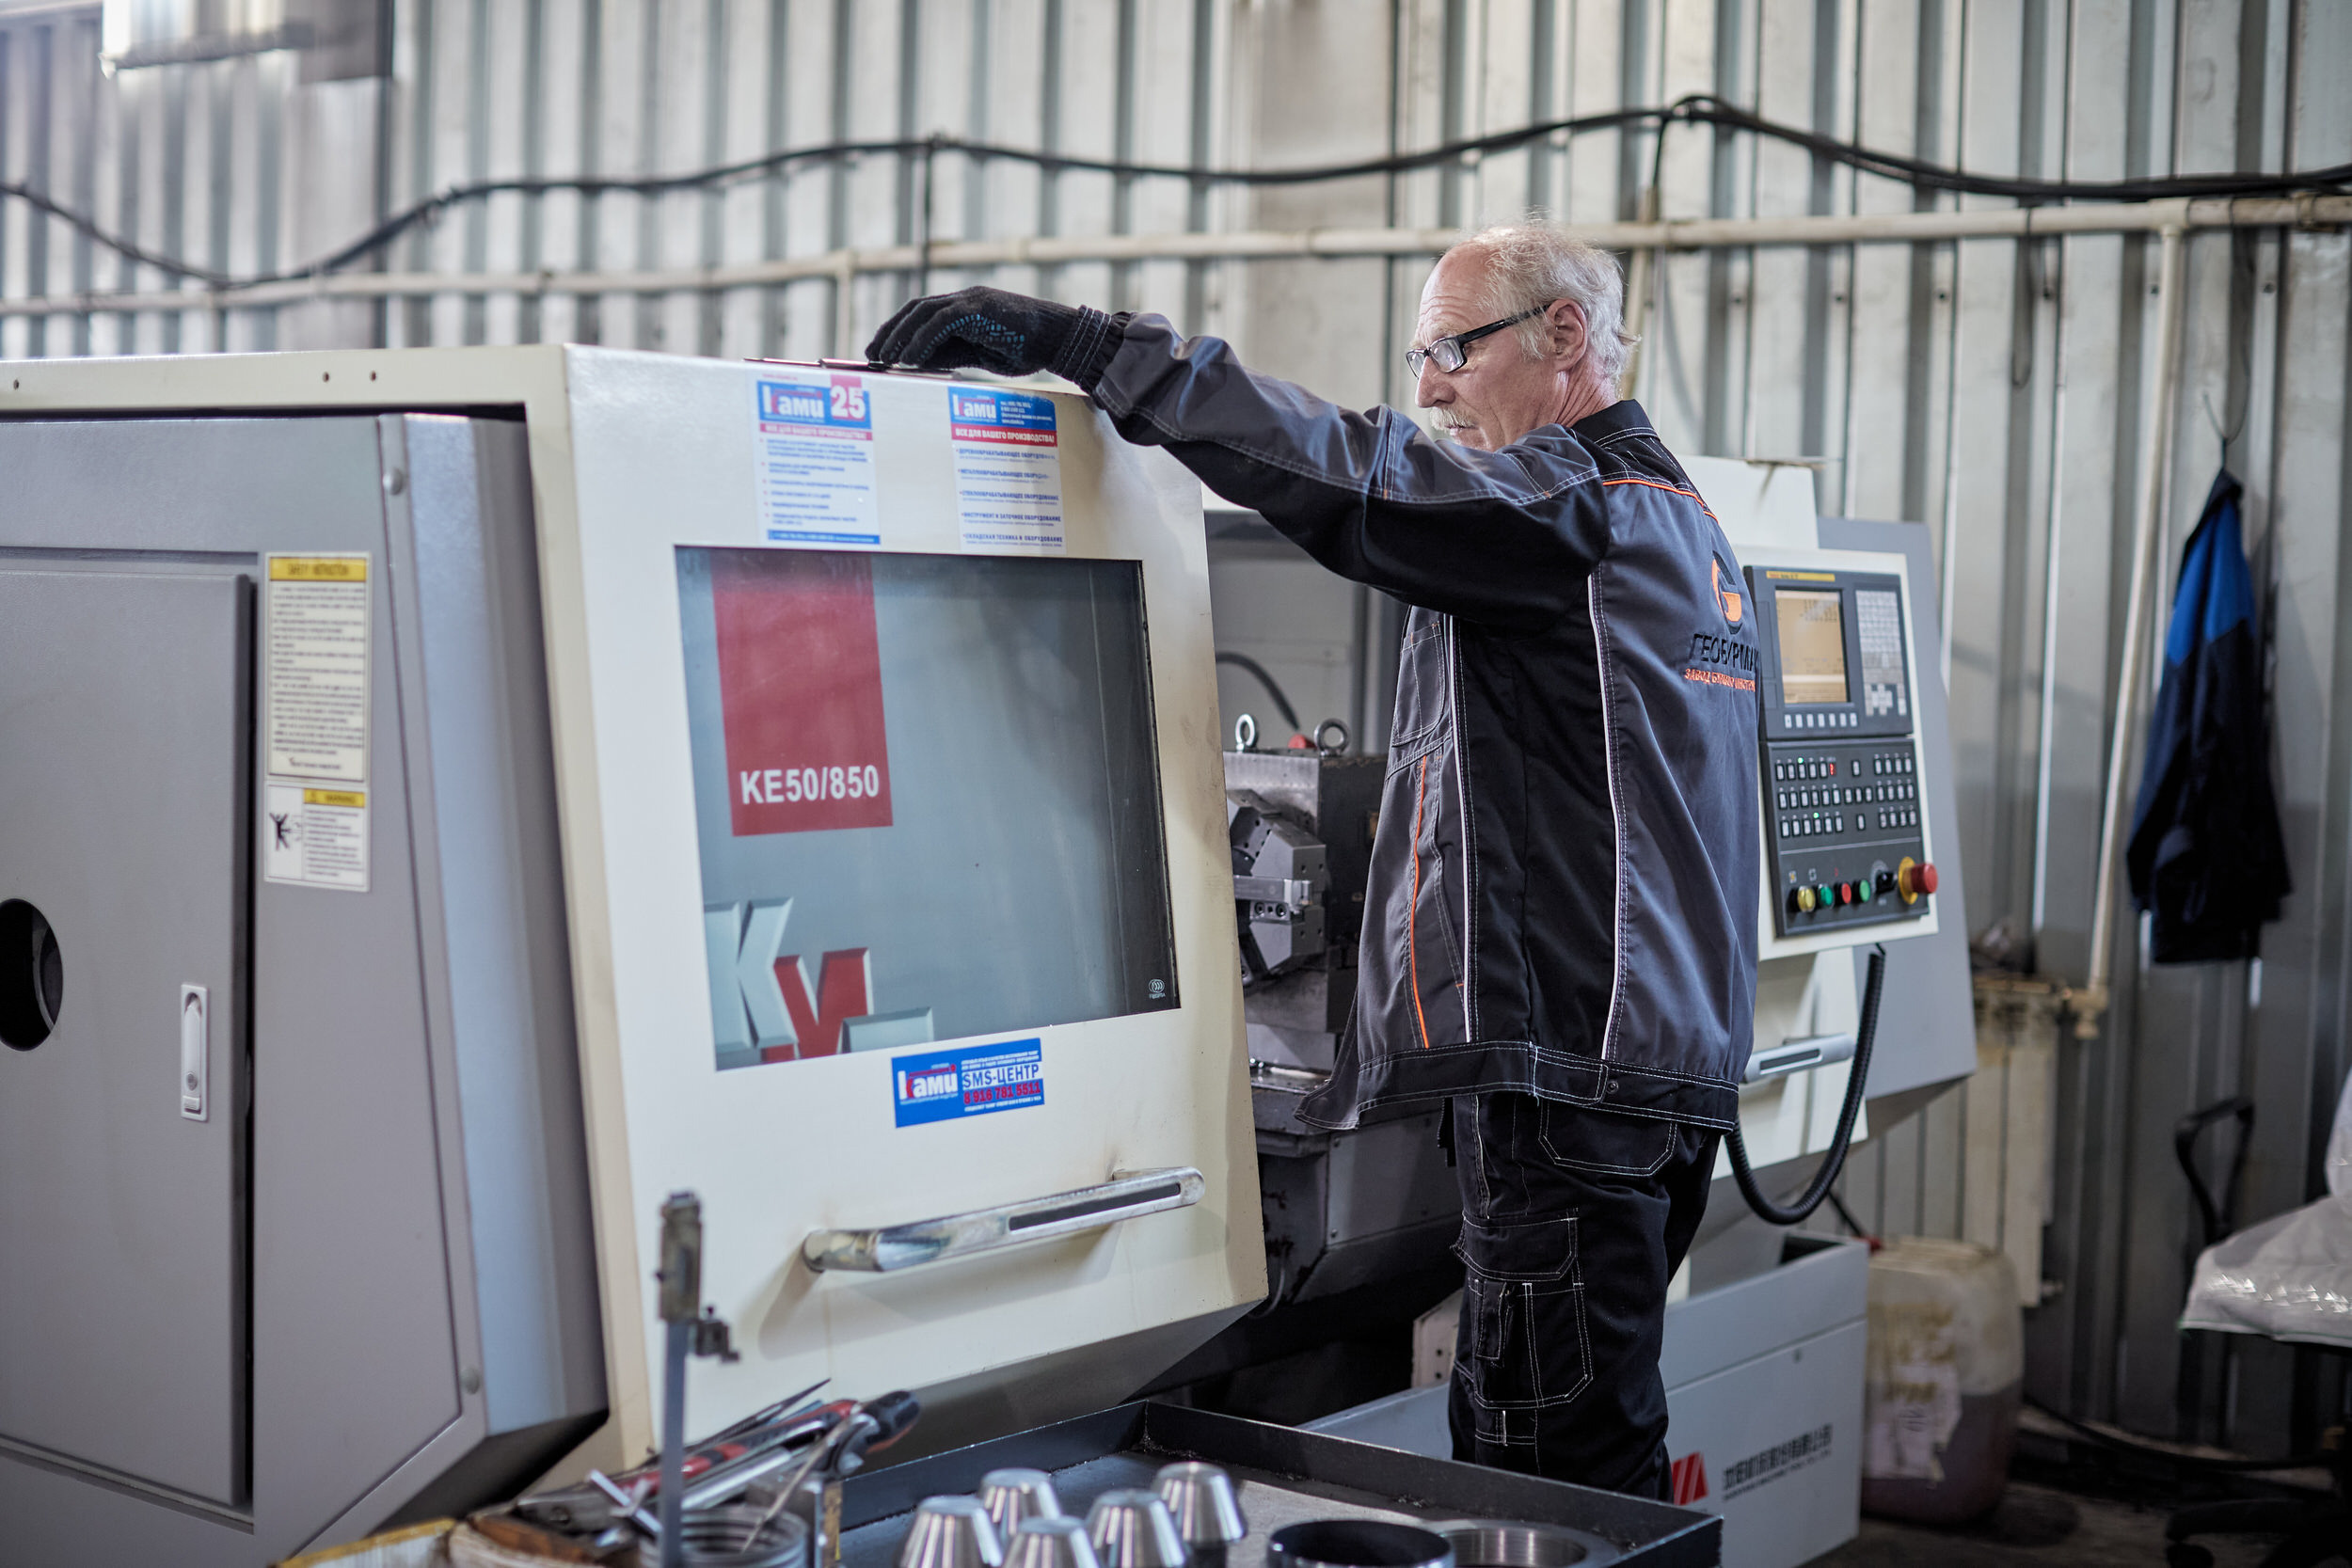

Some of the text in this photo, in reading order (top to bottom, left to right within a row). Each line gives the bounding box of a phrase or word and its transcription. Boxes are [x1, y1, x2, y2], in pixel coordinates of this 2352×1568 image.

[830, 385, 866, 420] 25
[1685, 669, 1710, 685] ЗАВОД
[739, 764, 880, 805] KE50/850
[961, 1063, 1040, 1089] SMS-ЦЕНТР
[963, 1091, 971, 1105] 8
[972, 1088, 993, 1103] 916
[994, 1085, 1014, 1100] 781
[1016, 1081, 1041, 1097] 5511
